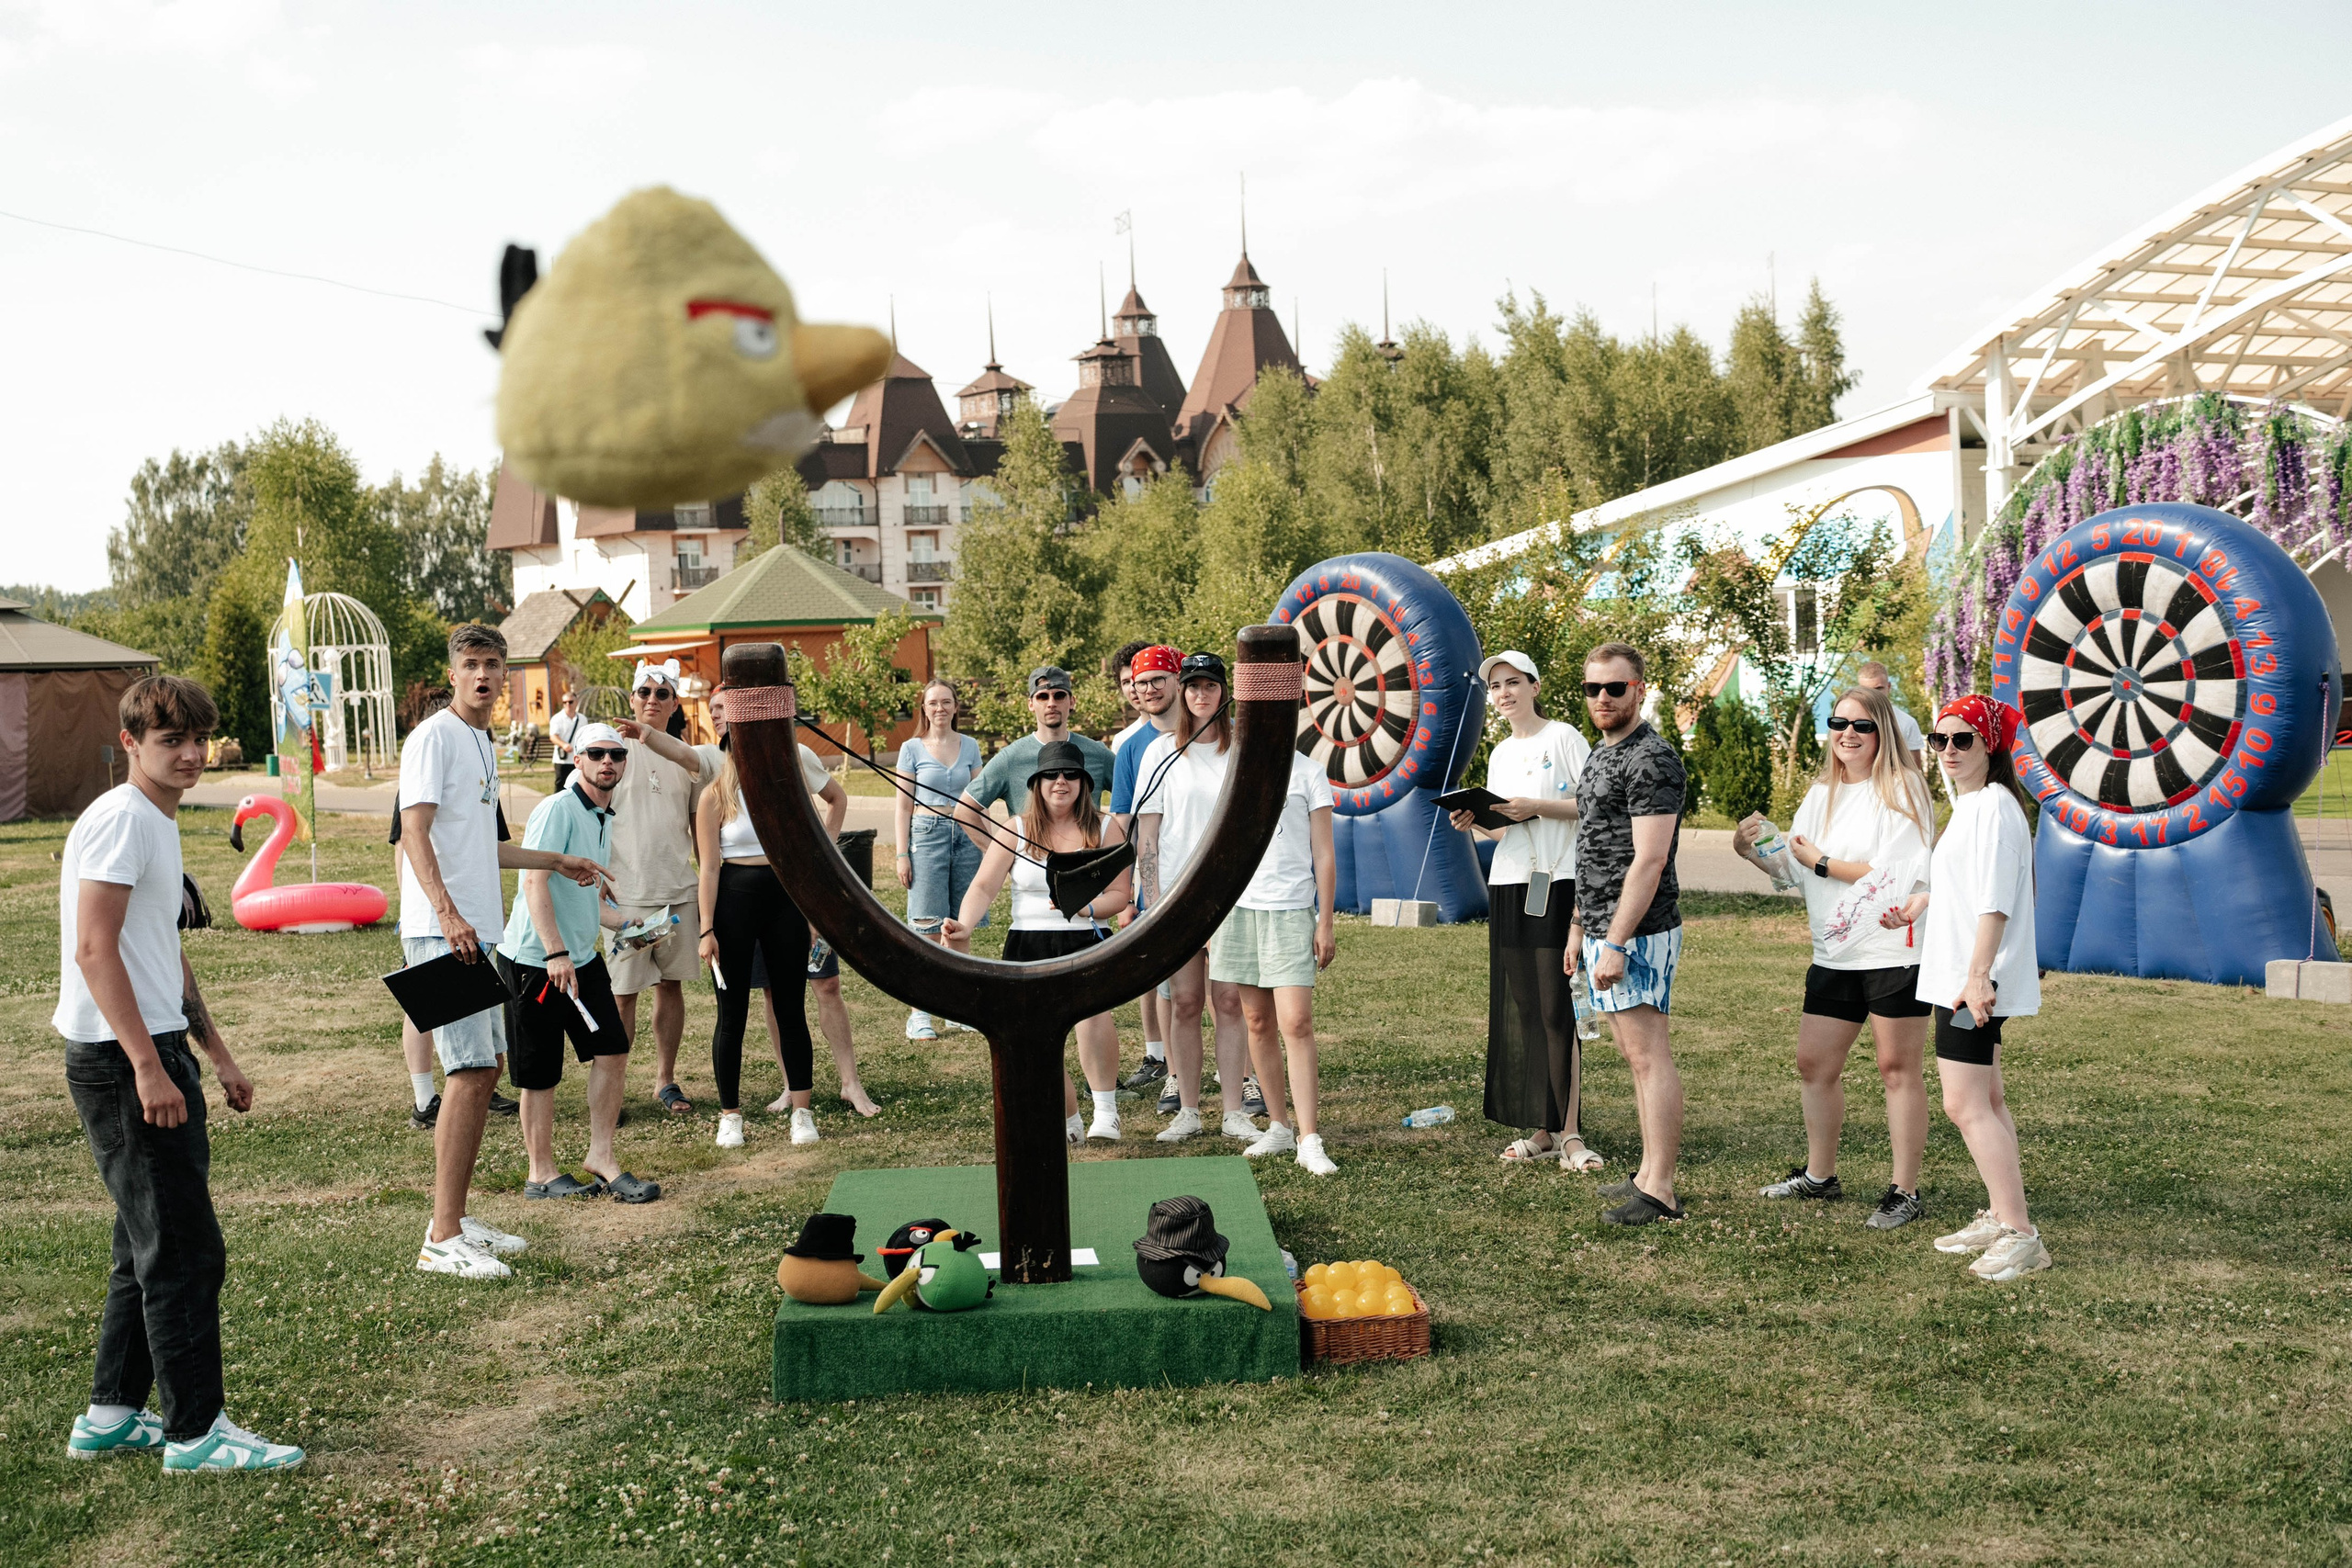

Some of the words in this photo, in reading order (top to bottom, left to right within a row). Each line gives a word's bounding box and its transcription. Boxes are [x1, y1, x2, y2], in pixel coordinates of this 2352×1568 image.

[2092, 524, 2111, 551] 5
[2120, 519, 2164, 547] 20
[2174, 531, 2195, 558] 1
[2041, 540, 2079, 577] 12
[1295, 583, 1315, 604] 12
[1319, 576, 1329, 591] 5
[1341, 573, 1362, 591] 20
[1370, 584, 1379, 599] 1
[2021, 578, 2041, 601] 9
[1278, 608, 1291, 624] 9
[2233, 597, 2262, 620] 4
[1998, 607, 2025, 645] 14
[2245, 630, 2278, 677] 13
[1418, 659, 1434, 686] 13
[1993, 652, 2012, 689] 11
[1415, 727, 1431, 751] 10
[2237, 727, 2274, 769] 10
[1397, 757, 1419, 780] 15
[1351, 791, 1372, 808] 17
[1381, 781, 1395, 798] 2
[2208, 768, 2249, 809] 15
[2056, 799, 2090, 834] 19
[2182, 804, 2209, 833] 2
[2099, 819, 2118, 845] 3
[2131, 817, 2171, 846] 17
